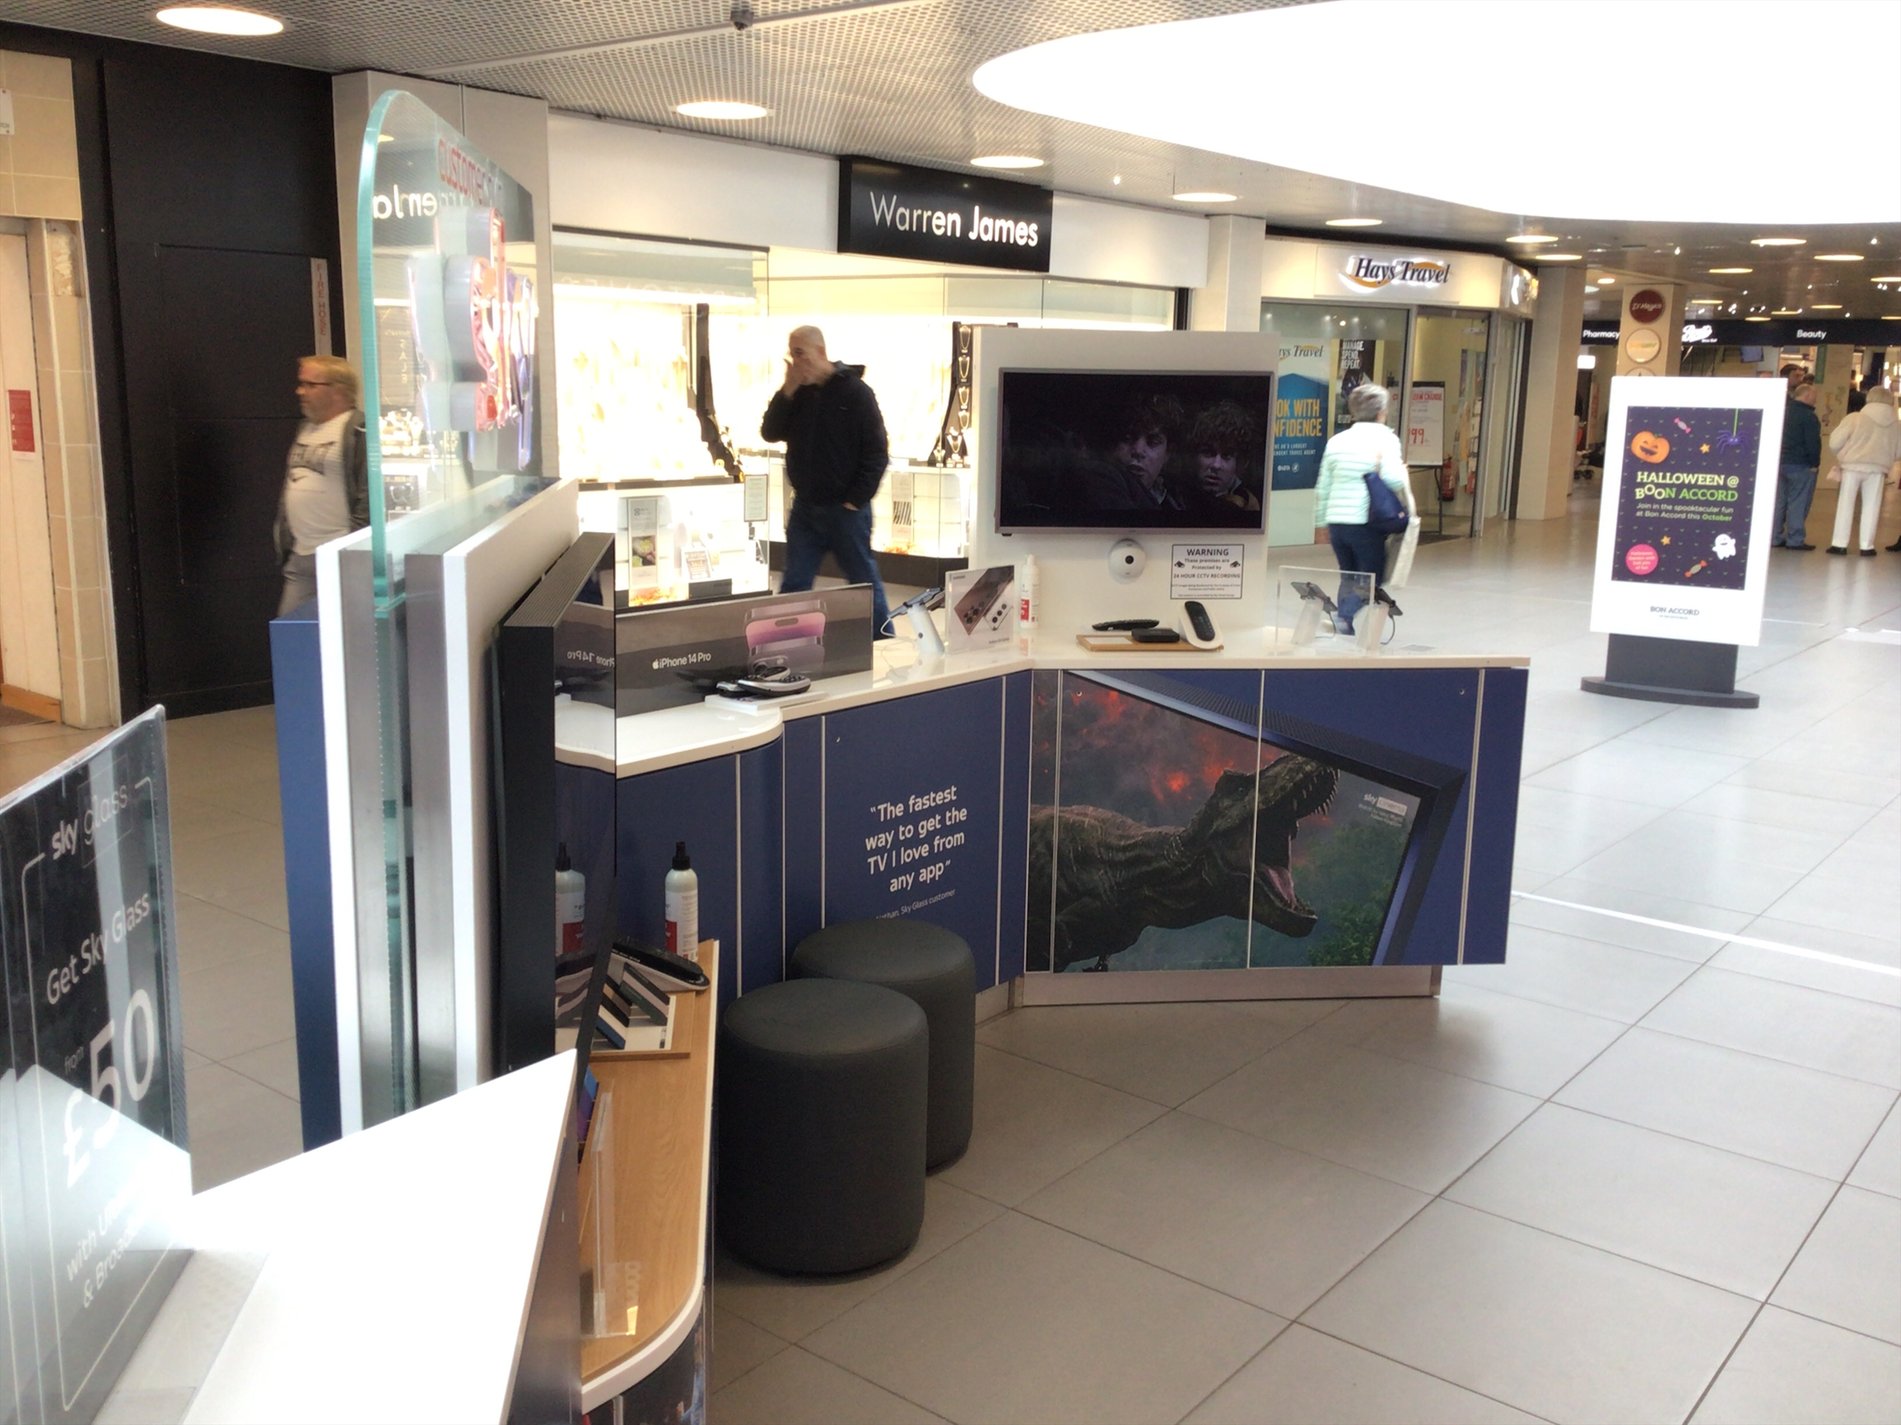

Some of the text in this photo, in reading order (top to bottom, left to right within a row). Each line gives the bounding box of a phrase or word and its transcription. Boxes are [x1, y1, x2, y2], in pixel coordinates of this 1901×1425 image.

[869, 190, 1039, 247] Warren James
[1354, 257, 1450, 284] Hays Travel
[1582, 330, 1620, 340] Pharmacy
[1796, 329, 1827, 340] Beauty
[1294, 345, 1324, 358] Travel
[1293, 399, 1320, 417] WITH
[1274, 418, 1322, 437] NFIDENCE
[1636, 471, 1740, 488] HALLOWEEN @
[1635, 484, 1738, 502] BOON ACCORD
[1660, 511, 1687, 519] Accord
[1674, 504, 1720, 513] spooktacular
[1186, 548, 1229, 556] WARNING
[1650, 605, 1700, 616] BON ACCORD
[659, 652, 712, 668] iPhone 14 Pro
[908, 785, 957, 814] fastest
[52, 785, 128, 860] sky glass
[865, 807, 967, 851] way to get the
[867, 832, 965, 875] TV I love from
[889, 871, 915, 892] any
[901, 904, 912, 914] Sky
[911, 899, 929, 910] Glass
[929, 889, 956, 903] customer
[47, 893, 150, 1005] Get Sky Glass
[64, 1046, 84, 1076] from
[63, 988, 155, 1189] £50
[66, 1229, 97, 1282] with
[83, 1279, 94, 1308] &
